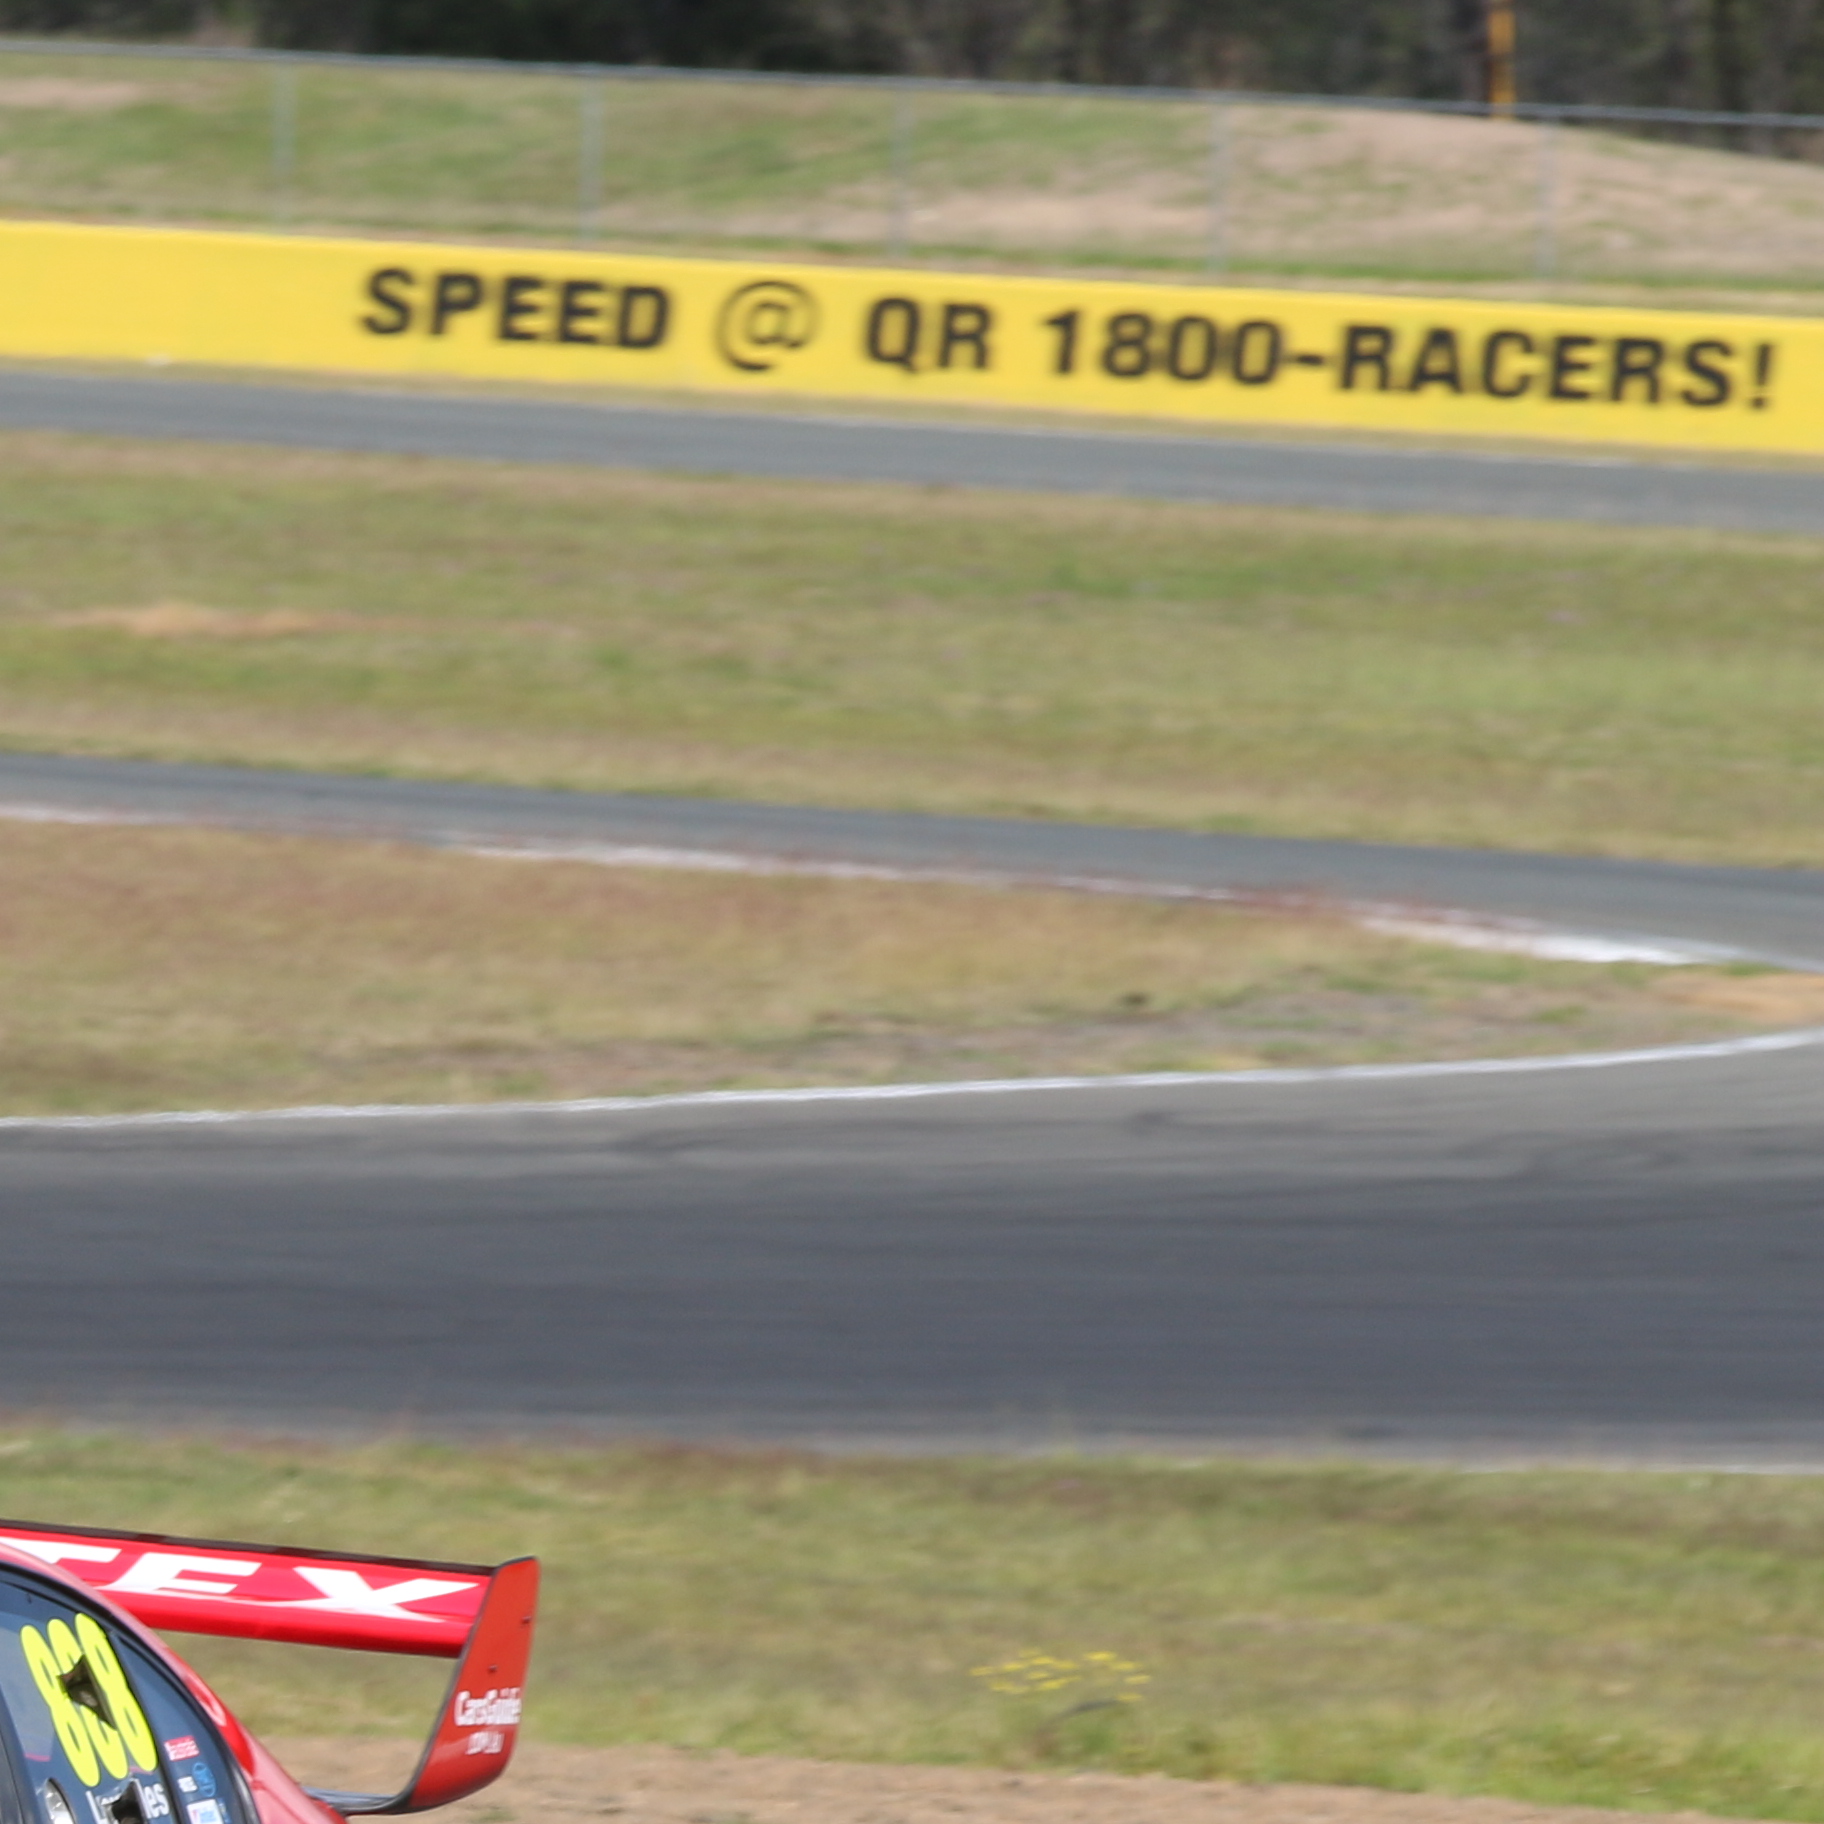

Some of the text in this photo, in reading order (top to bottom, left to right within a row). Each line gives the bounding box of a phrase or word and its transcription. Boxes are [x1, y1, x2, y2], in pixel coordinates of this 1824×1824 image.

[360, 267, 1776, 412] SPEED @ QR 1800-RACERS!
